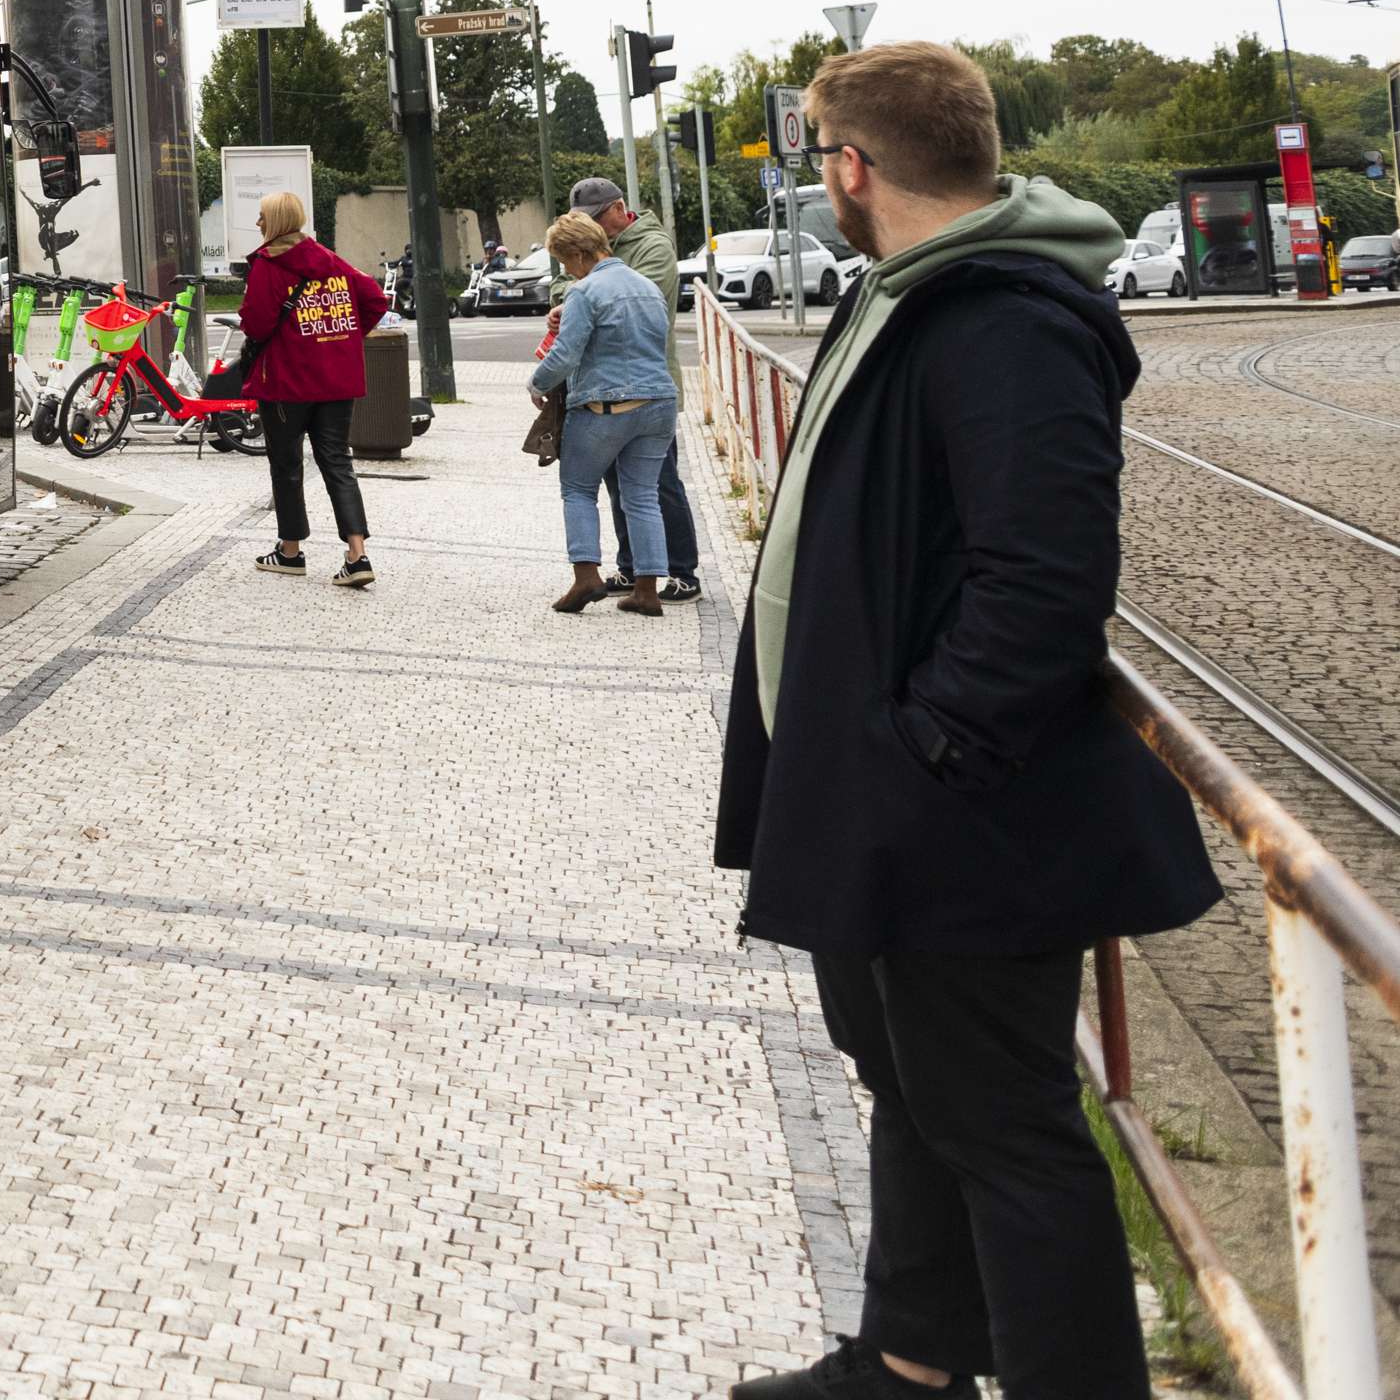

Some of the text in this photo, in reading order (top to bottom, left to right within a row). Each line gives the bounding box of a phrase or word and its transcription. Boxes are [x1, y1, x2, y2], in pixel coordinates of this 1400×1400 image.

[458, 15, 505, 30] Pražský hrad
[296, 303, 353, 322] HOP-OFF
[300, 316, 358, 336] EXPLORE
